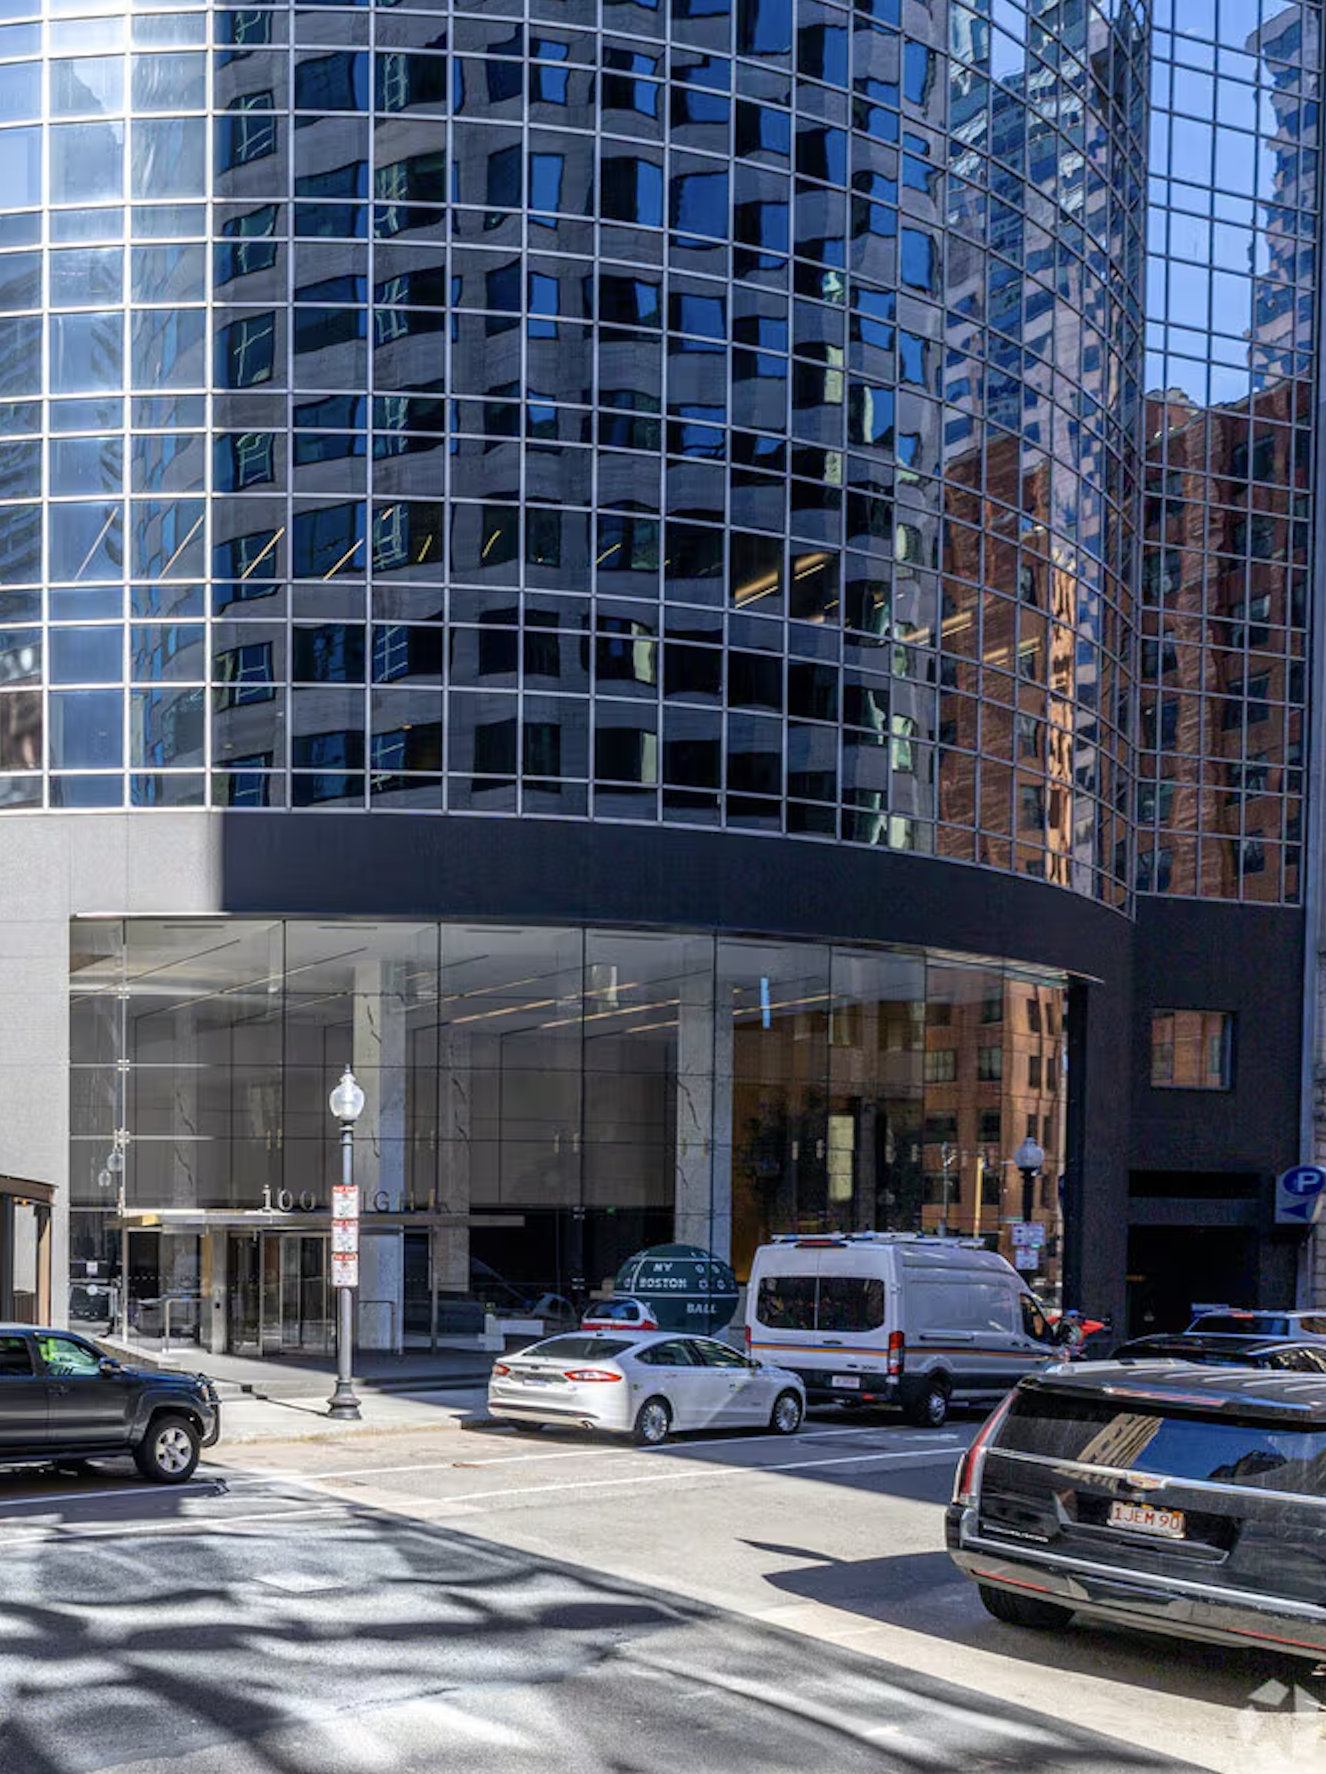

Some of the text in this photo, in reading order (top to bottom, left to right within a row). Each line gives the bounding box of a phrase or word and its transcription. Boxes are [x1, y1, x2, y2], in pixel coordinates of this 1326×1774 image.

[1297, 1171, 1321, 1193] P
[261, 1185, 316, 1212] 100
[638, 1278, 687, 1289] BOSTON
[686, 1303, 717, 1314] BALL
